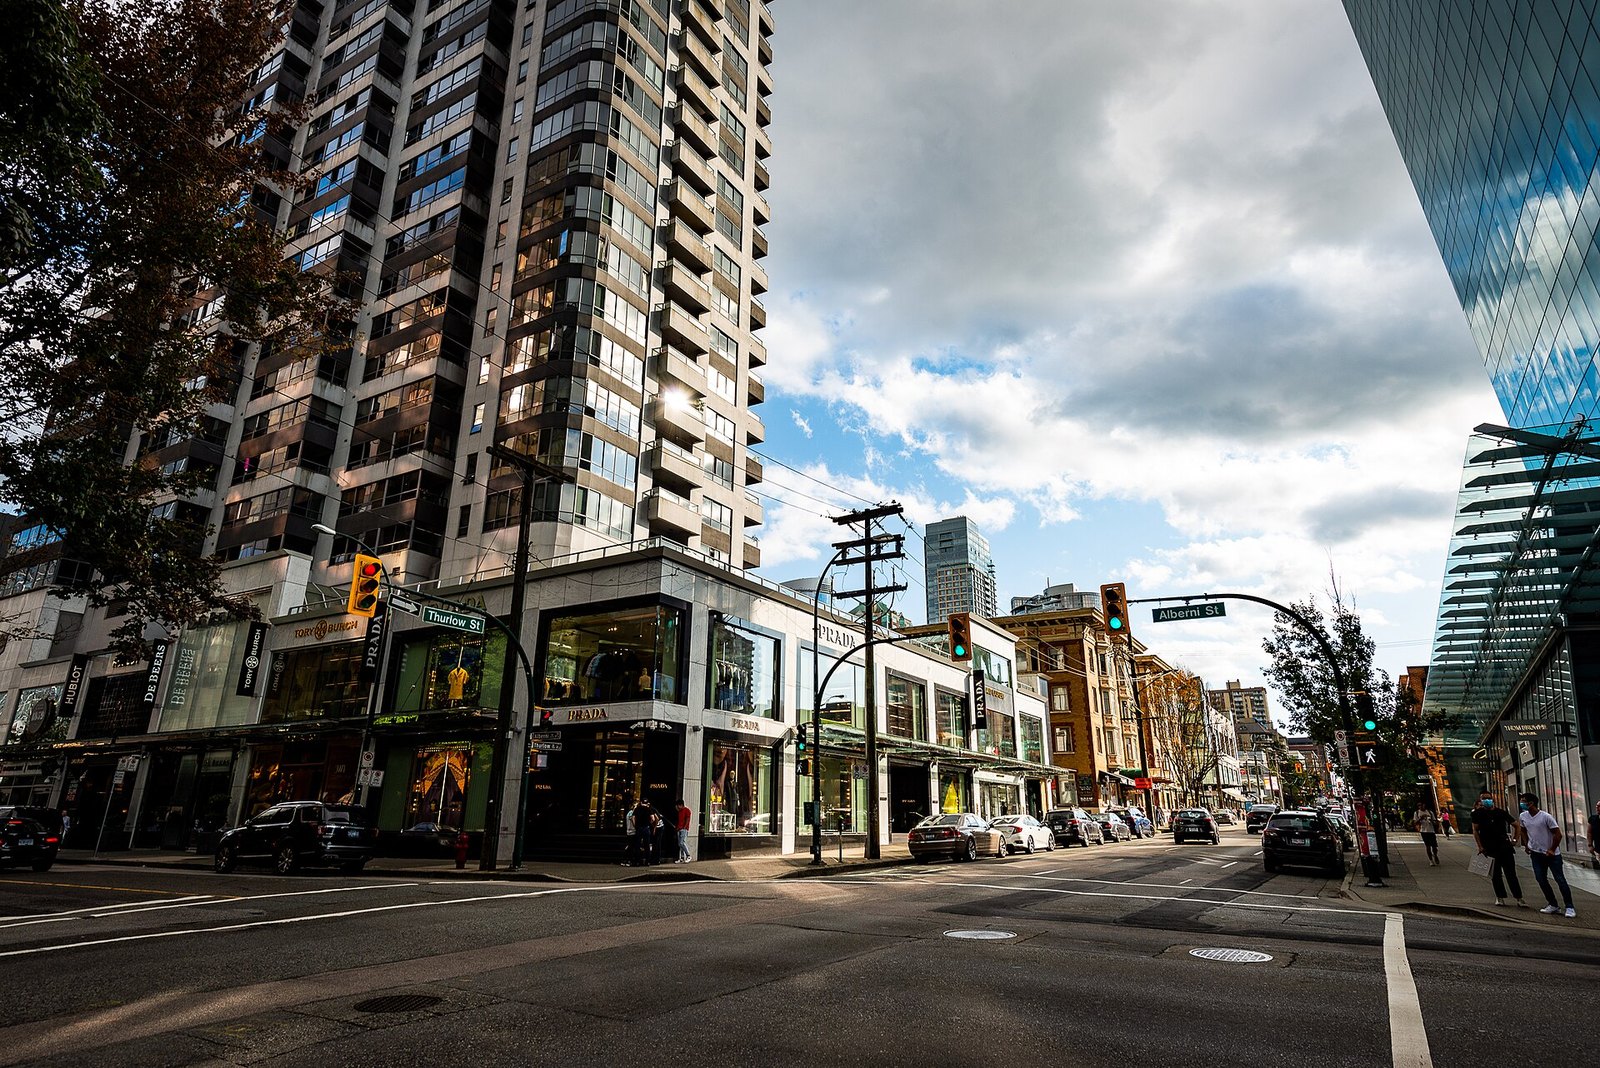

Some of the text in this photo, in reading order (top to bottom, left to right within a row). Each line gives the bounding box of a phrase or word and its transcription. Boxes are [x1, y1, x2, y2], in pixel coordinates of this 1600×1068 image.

[428, 610, 481, 631] Thurlow St
[1159, 605, 1220, 620] Alberni St
[295, 620, 358, 639] TORY BURCH
[366, 614, 384, 668] PRADA
[817, 623, 857, 649] PRADA
[243, 628, 262, 689] TORY BURCH
[64, 664, 83, 705] HUBLOT
[143, 643, 167, 703] DE BEERS
[975, 679, 985, 719] PRADA
[568, 707, 608, 721] PRADA
[731, 716, 761, 732] PRADA
